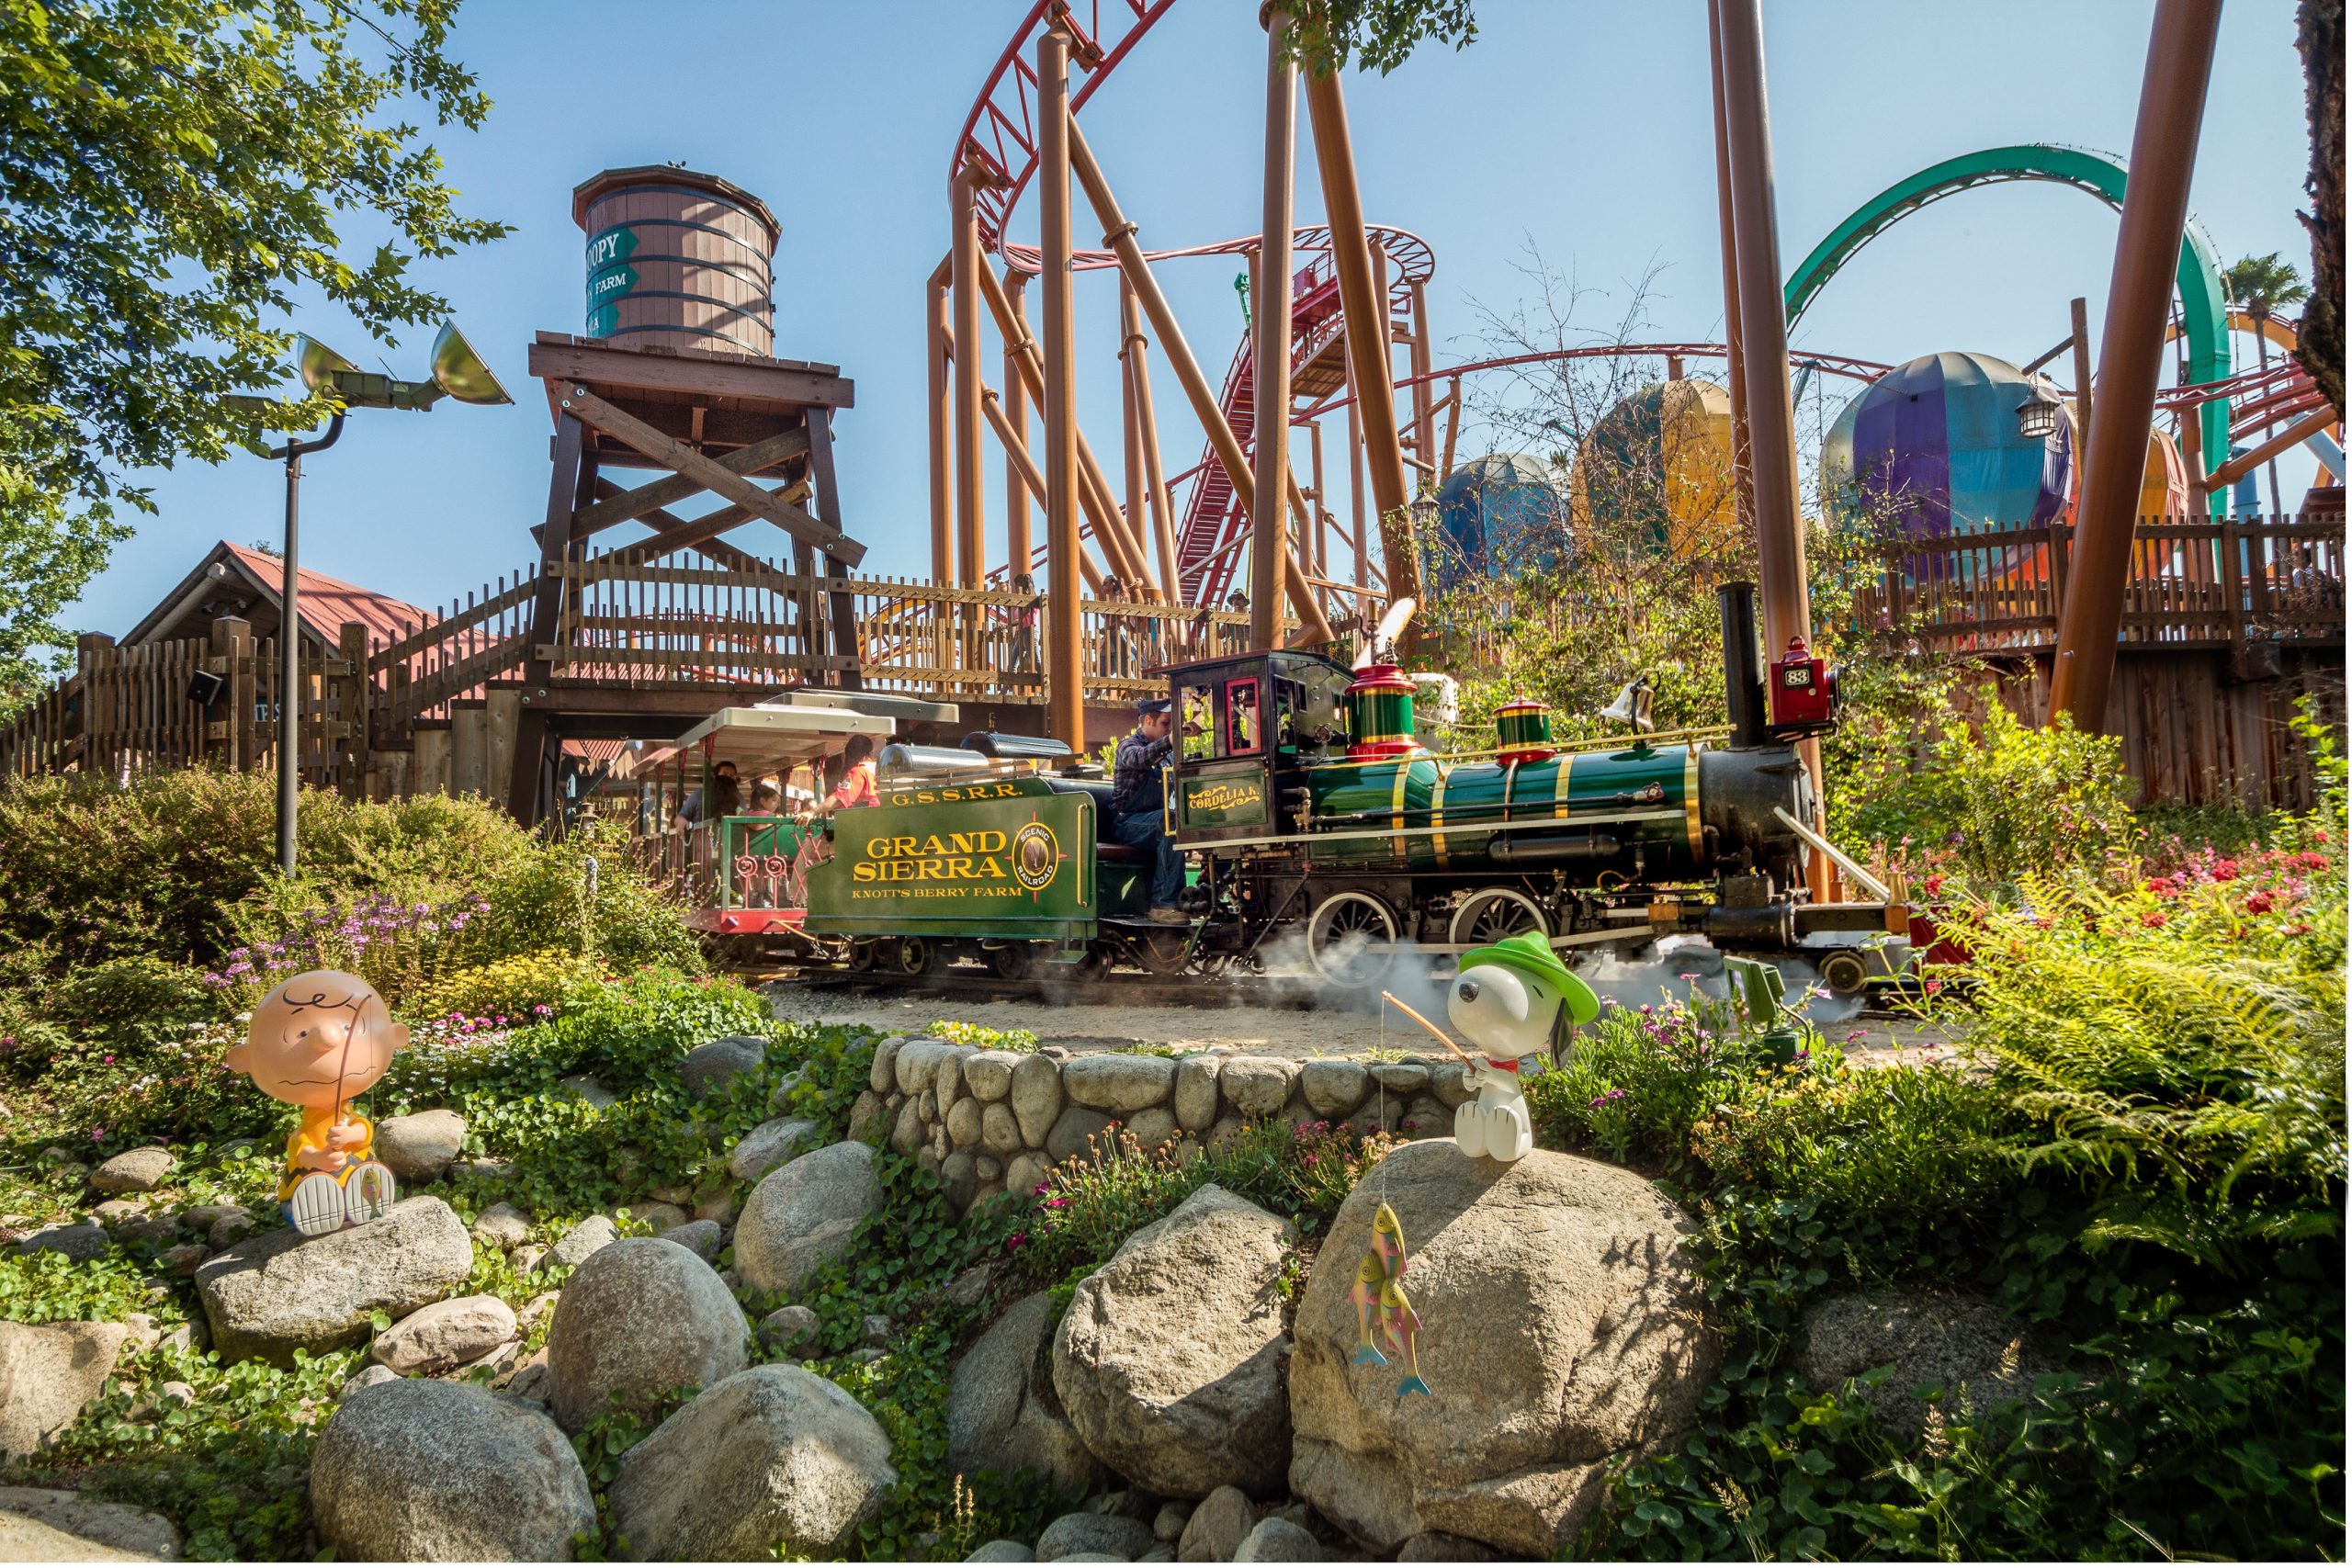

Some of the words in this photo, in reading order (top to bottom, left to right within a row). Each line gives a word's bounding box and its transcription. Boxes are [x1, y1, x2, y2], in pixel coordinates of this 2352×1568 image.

[595, 273, 627, 294] FARM
[1787, 671, 1808, 683] 83
[1189, 787, 1246, 809] CORDELIA
[866, 830, 1007, 859] GRAND
[1020, 828, 1050, 842] SCENIC
[853, 856, 1007, 882] SIERRA
[1017, 864, 1054, 886] RAILROAD
[852, 888, 910, 898] KNOTT'S
[914, 887, 969, 897] BERRY
[973, 887, 1023, 897] FARM
